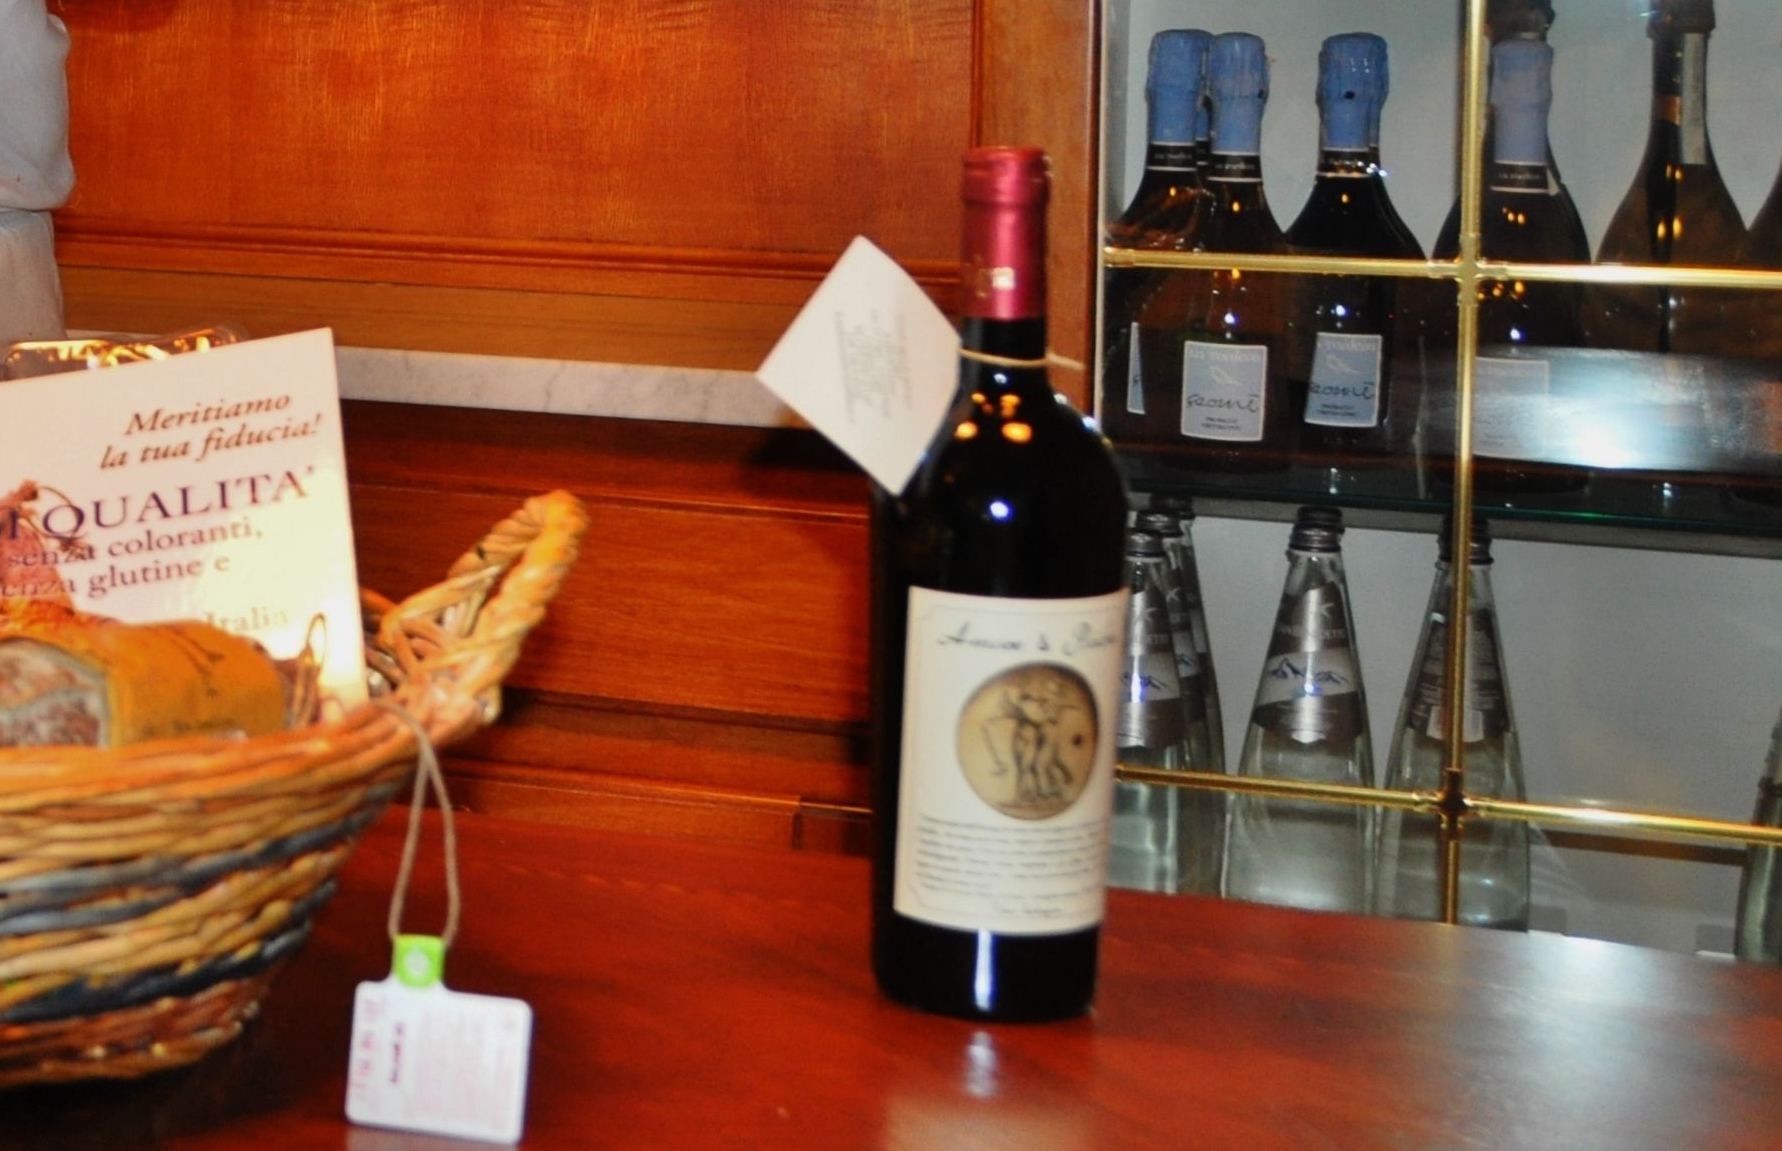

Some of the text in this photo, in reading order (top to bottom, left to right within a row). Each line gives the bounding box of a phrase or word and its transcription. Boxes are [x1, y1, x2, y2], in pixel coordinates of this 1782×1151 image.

[125, 395, 290, 436] Meritiamo
[100, 412, 322, 469] la tua fiducia!
[42, 465, 314, 541] QUALITA'
[106, 517, 264, 559] coloranti,
[87, 560, 203, 599] glutine
[214, 555, 230, 572] e
